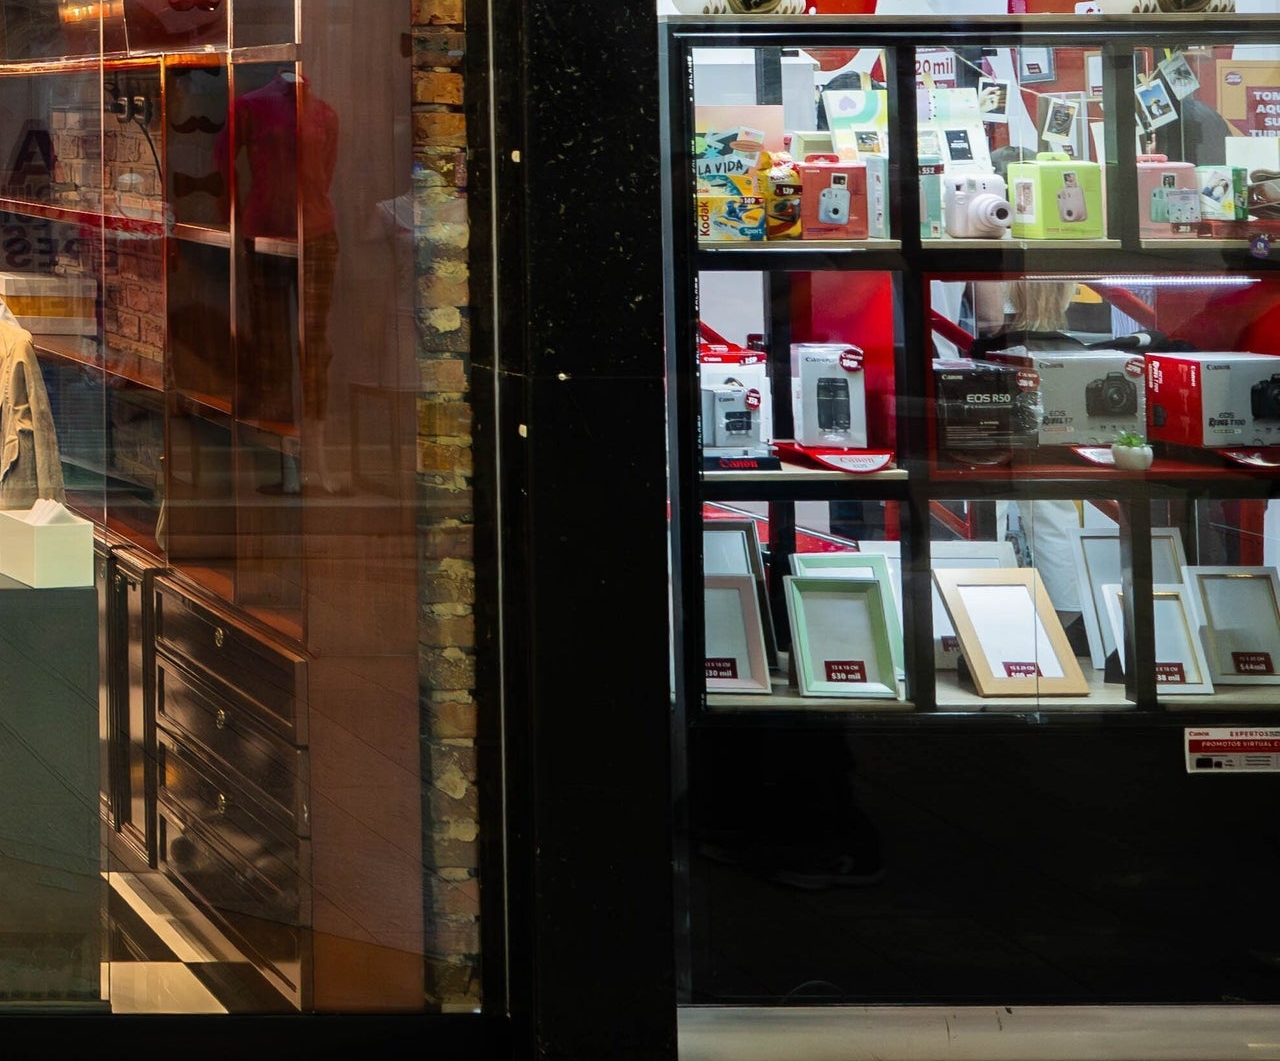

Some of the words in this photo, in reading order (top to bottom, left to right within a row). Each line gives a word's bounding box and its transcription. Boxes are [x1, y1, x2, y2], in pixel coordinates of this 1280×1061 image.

[933, 57, 954, 75] mil
[715, 159, 744, 174] VIDA
[700, 201, 710, 237] Kodak
[966, 393, 991, 403] EOS
[992, 393, 1011, 403] R50
[719, 459, 759, 469] Canon
[848, 672, 861, 680] mil
